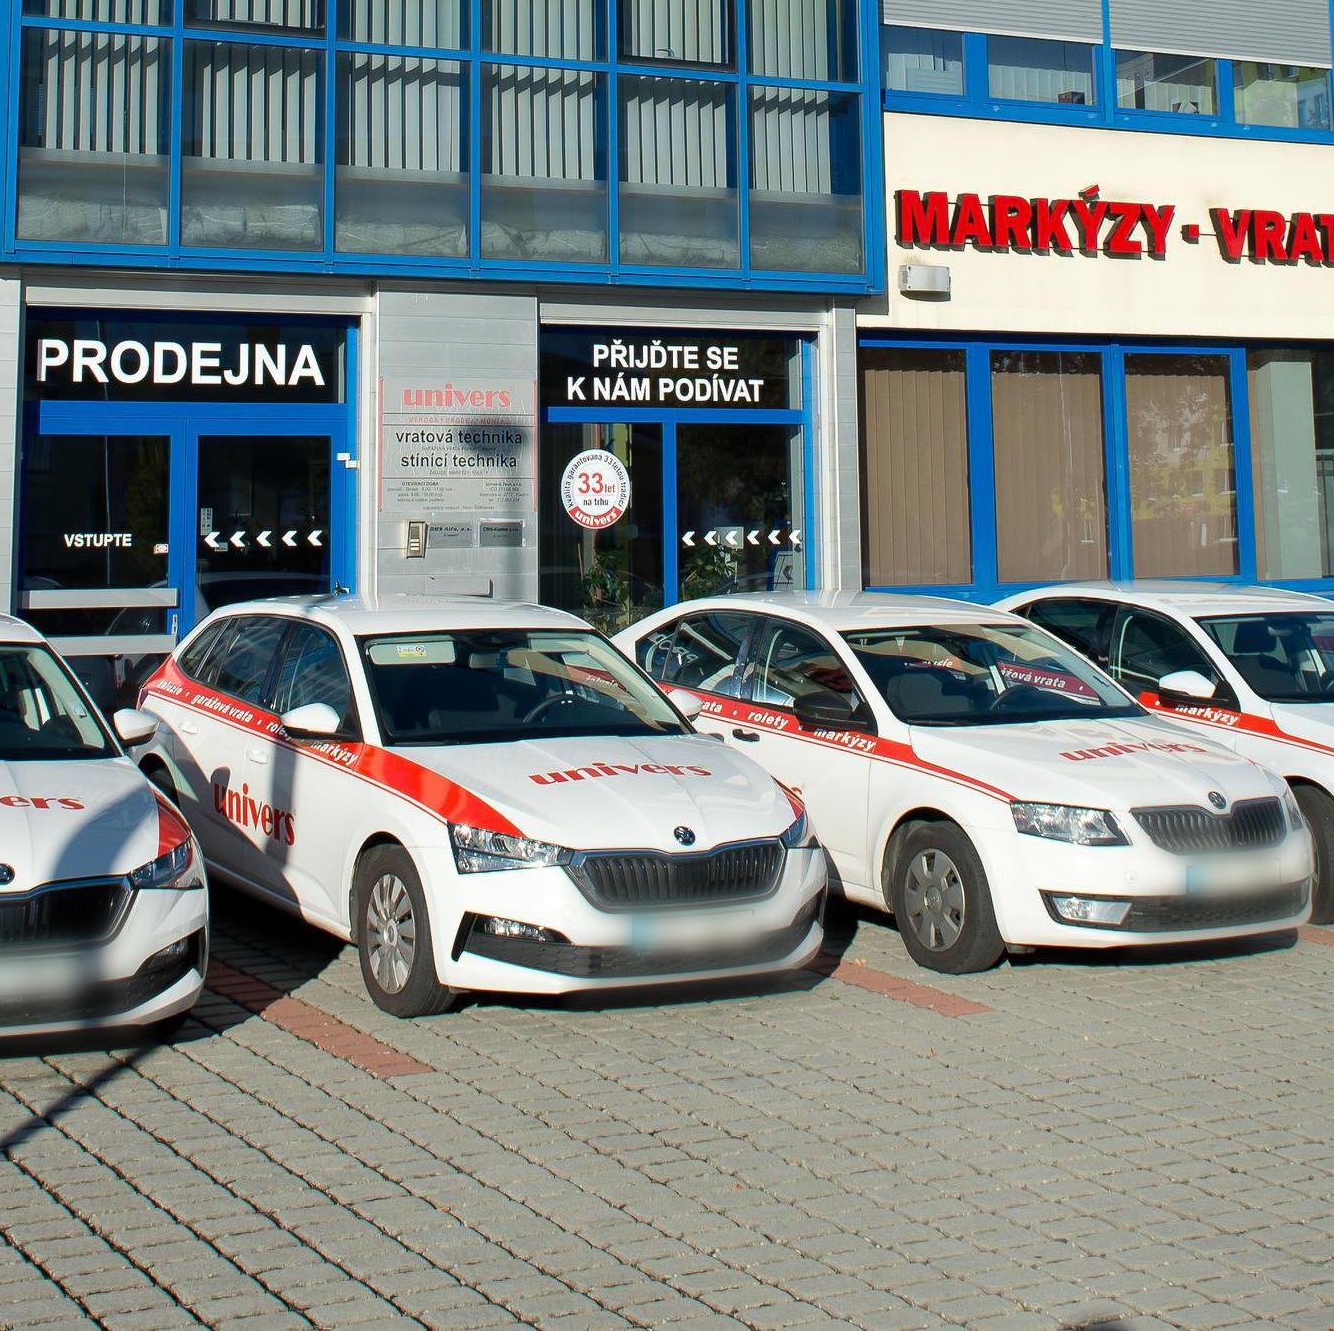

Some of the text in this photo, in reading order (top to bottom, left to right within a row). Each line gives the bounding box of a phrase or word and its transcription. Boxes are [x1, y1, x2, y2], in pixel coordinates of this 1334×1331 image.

[896, 185, 1175, 259] MARKÝZY
[37, 338, 326, 386] PRODEJNA
[593, 338, 739, 370] PŘIJĎTE SE
[403, 382, 511, 408] univers
[567, 372, 765, 402] K NÁM PODÍVAT
[396, 429, 523, 444] vratová technika
[401, 453, 517, 468] stínící technika
[578, 472, 616, 494] 33 let
[594, 498, 609, 506] trhu
[574, 508, 618, 526] univers
[64, 533, 132, 548] VSTUPTE
[1034, 676, 1066, 689] vrata
[191, 693, 230, 716] garážová
[230, 705, 254, 723] vrata
[699, 699, 877, 752] ata rolety markýzy
[1058, 741, 1208, 761] univers
[528, 762, 713, 785] univers
[213, 782, 295, 846] univers
